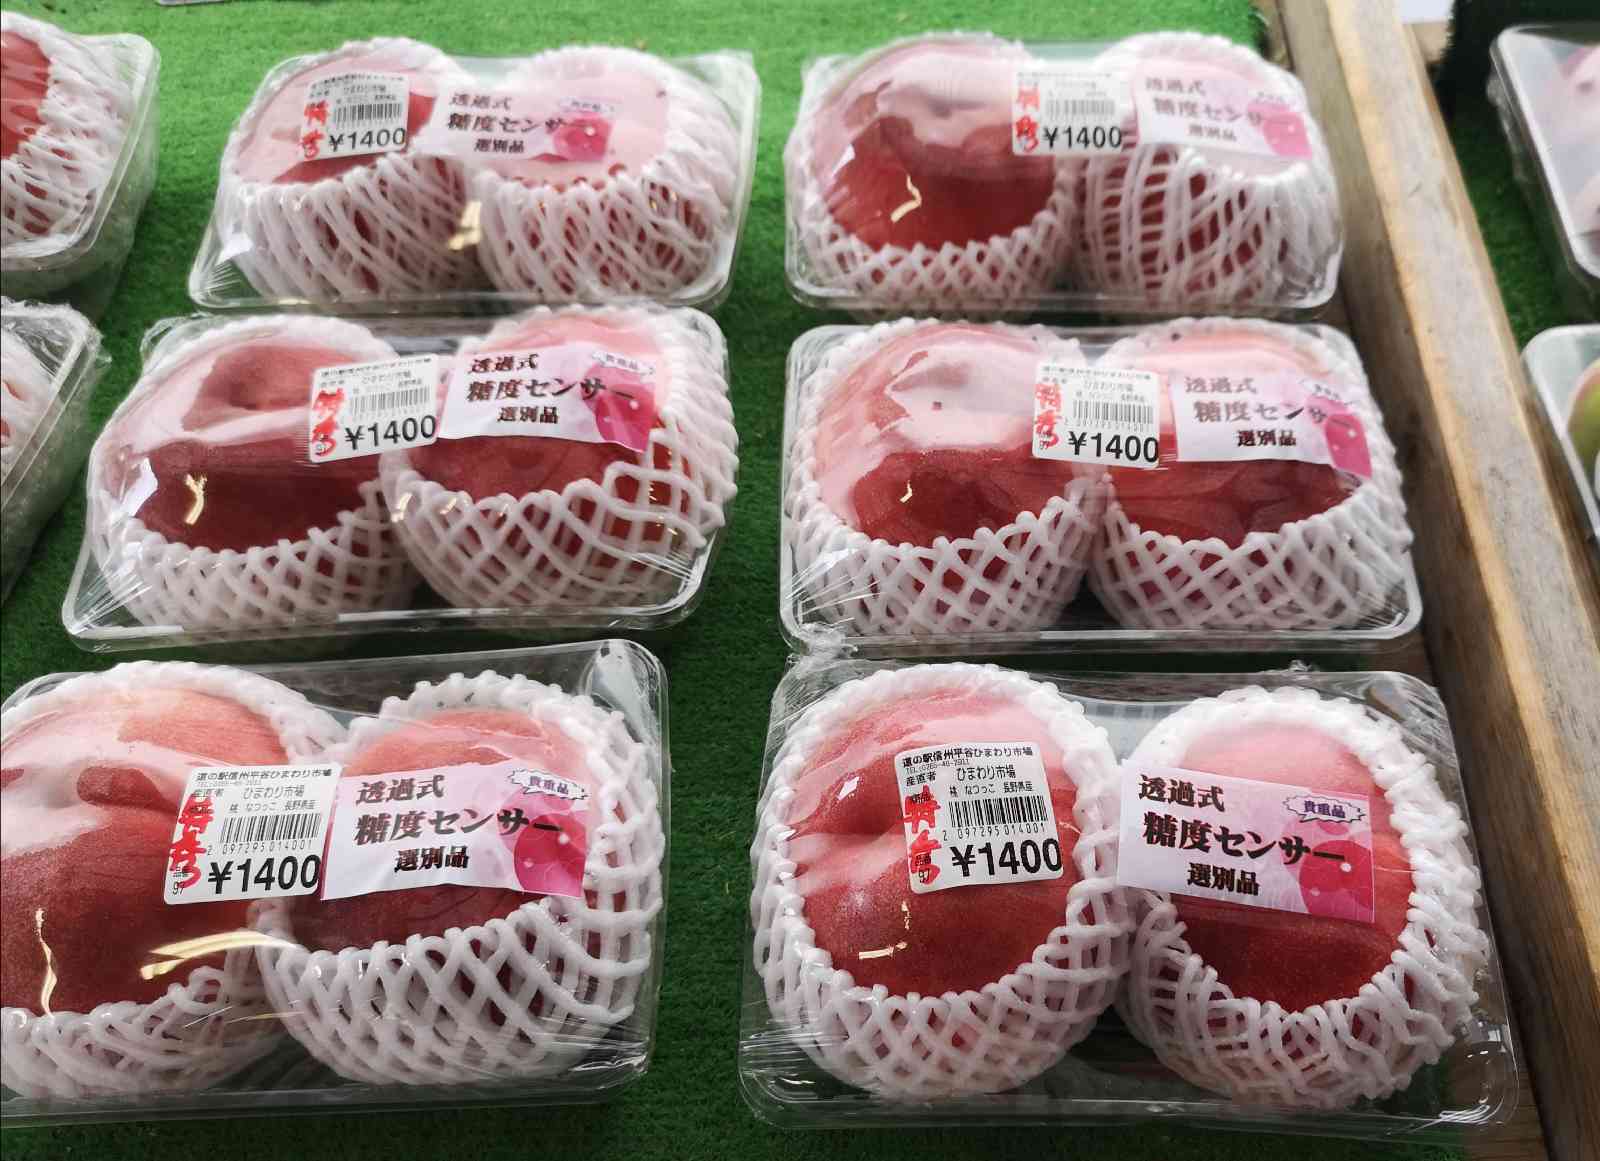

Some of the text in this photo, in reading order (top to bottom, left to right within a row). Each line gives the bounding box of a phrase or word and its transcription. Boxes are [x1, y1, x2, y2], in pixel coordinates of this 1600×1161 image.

[329, 127, 406, 153] ¥1400
[1041, 125, 1122, 149] ¥1400
[468, 354, 539, 375] 透過式
[467, 377, 635, 402] 糖度センサー
[1185, 376, 1257, 395] 透過式
[497, 405, 559, 424] 選別品
[345, 415, 436, 450] ¥1400
[1236, 429, 1297, 447] 選別品
[1067, 431, 1158, 463] ¥1400
[903, 746, 1033, 768] 道の駅信州平谷ひまわり市場
[956, 764, 1016, 781] ひまわり市場
[243, 785, 305, 800] ひまわり市場
[355, 774, 445, 804] 透過式
[965, 783, 996, 795] なつっこ
[1003, 781, 1033, 793] 長野県産
[1138, 774, 1226, 812] 透過式
[1303, 799, 1346, 819] 貴重品
[354, 807, 563, 846] 糖度センサー
[1142, 811, 1345, 865] 糖度センサー
[394, 846, 469, 873] 選別品
[949, 838, 1062, 877] ¥1400
[208, 854, 321, 895] ¥1400
[1187, 861, 1260, 896] 選別品
